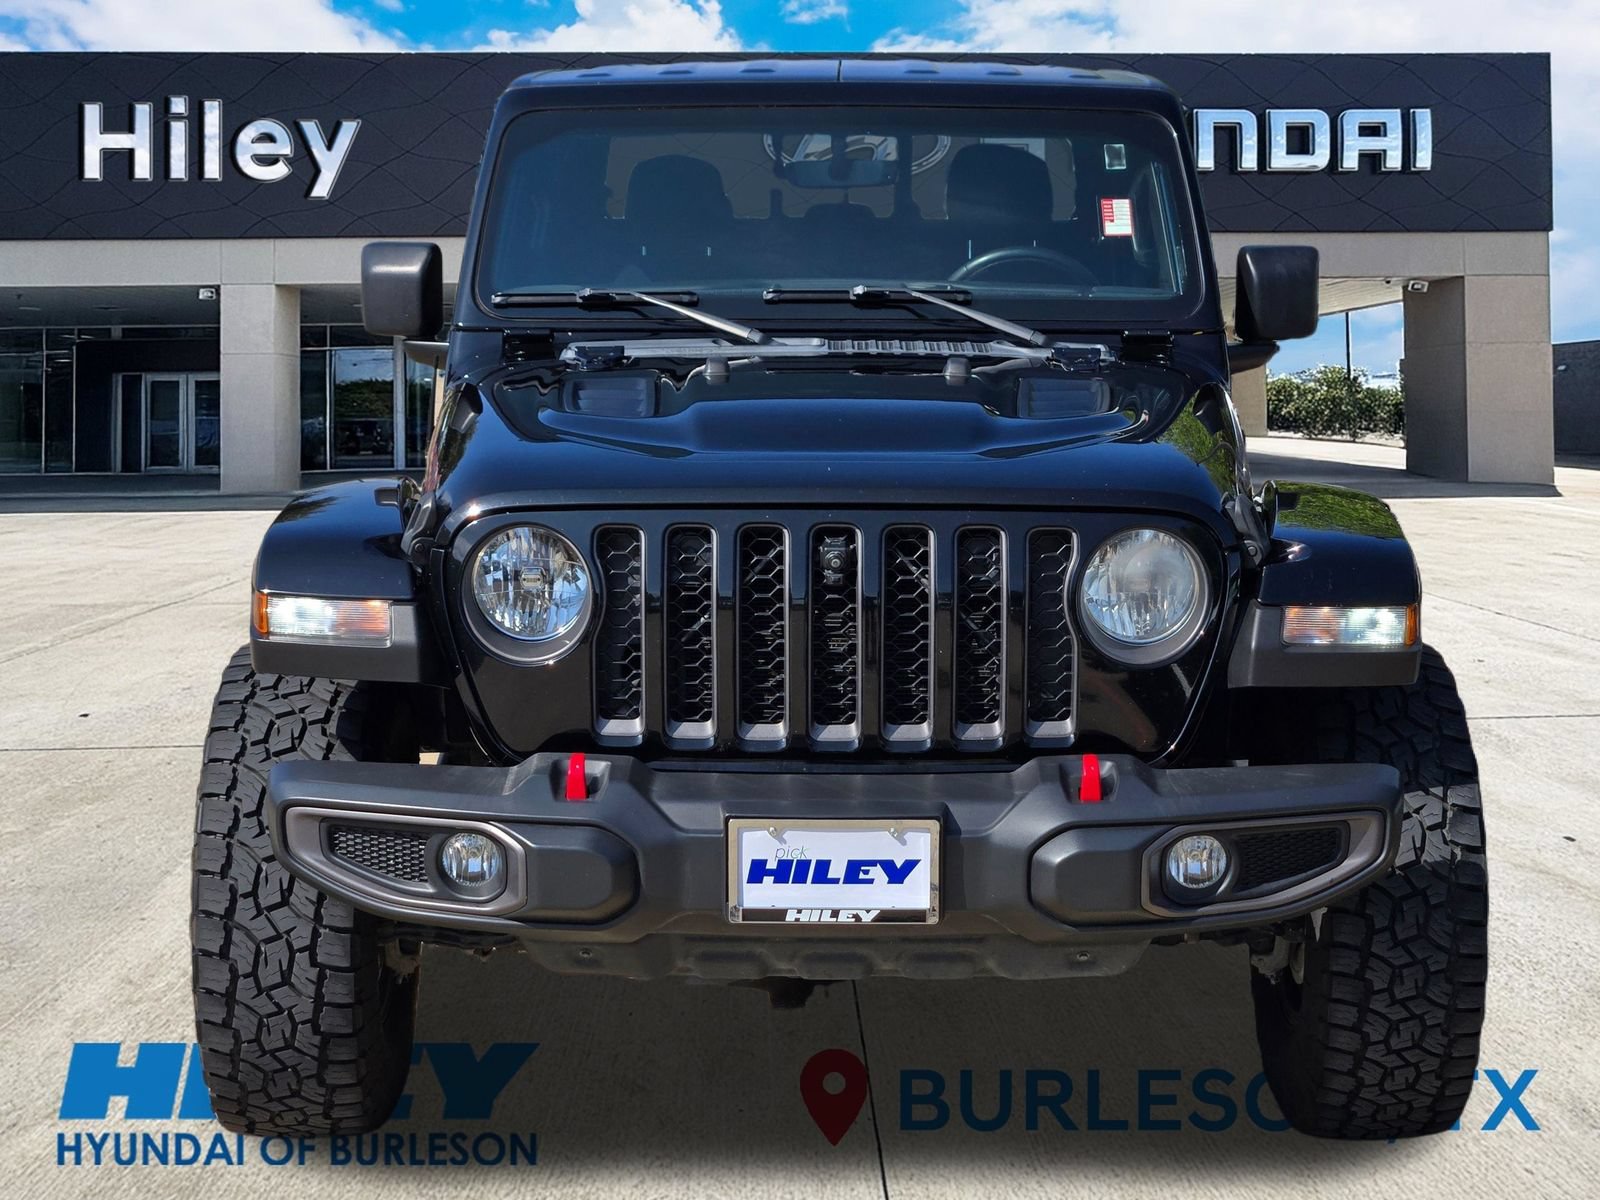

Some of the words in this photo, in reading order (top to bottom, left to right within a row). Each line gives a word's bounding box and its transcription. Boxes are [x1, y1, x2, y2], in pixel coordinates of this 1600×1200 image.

[81, 95, 361, 200] Hiley
[1193, 108, 1433, 171] NDAI
[775, 845, 808, 861] pick
[746, 858, 922, 885] HILEY
[785, 909, 880, 922] HILEY
